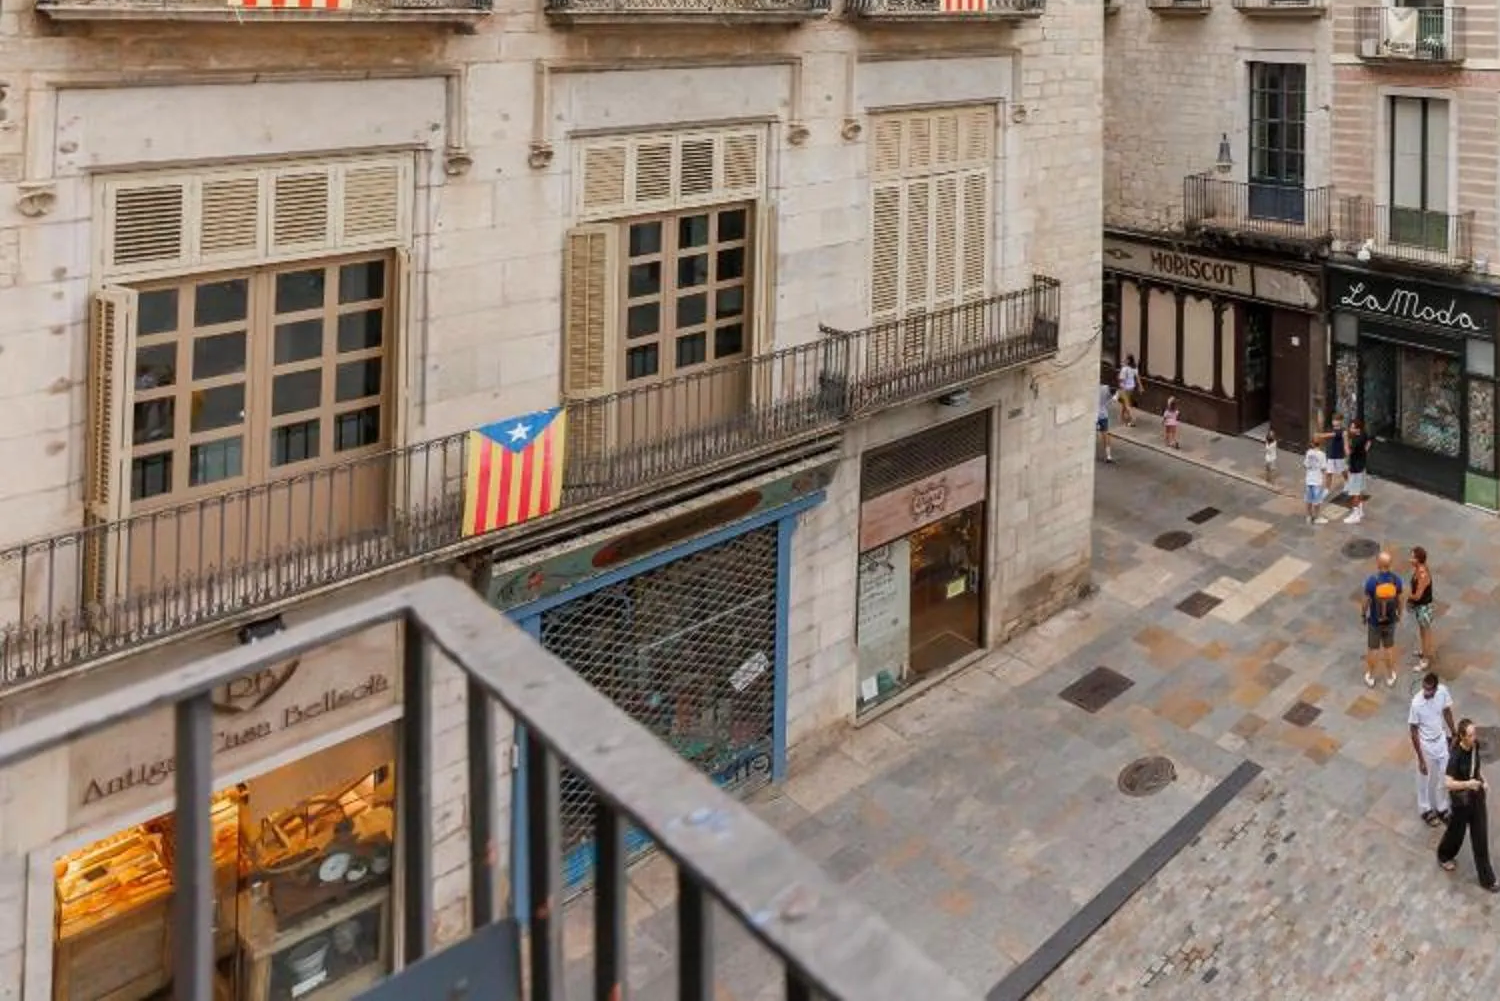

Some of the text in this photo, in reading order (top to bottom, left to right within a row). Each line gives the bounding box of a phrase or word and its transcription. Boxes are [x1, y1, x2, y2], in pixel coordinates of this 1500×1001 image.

[1150, 249, 1237, 286] MORISCOT
[1341, 282, 1479, 330] La Moda
